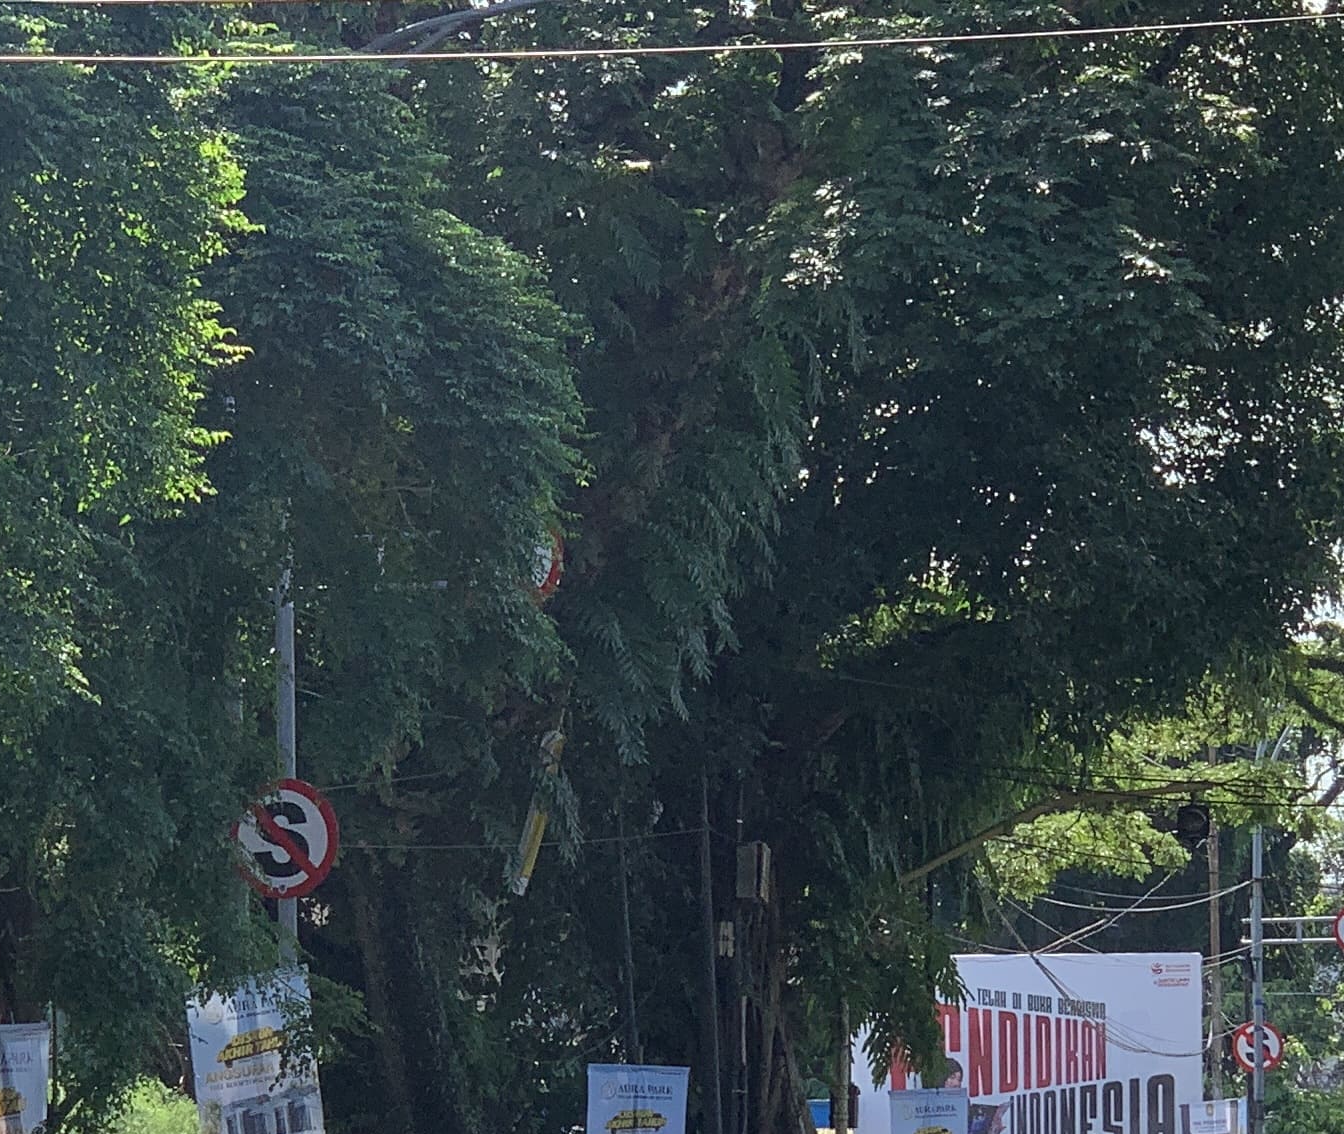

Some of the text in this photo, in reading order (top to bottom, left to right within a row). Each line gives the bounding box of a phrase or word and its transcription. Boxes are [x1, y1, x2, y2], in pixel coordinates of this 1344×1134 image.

[977, 988, 1007, 1010] TELAH
[1012, 992, 1022, 1010] DI
[1027, 994, 1053, 1014] BUKA
